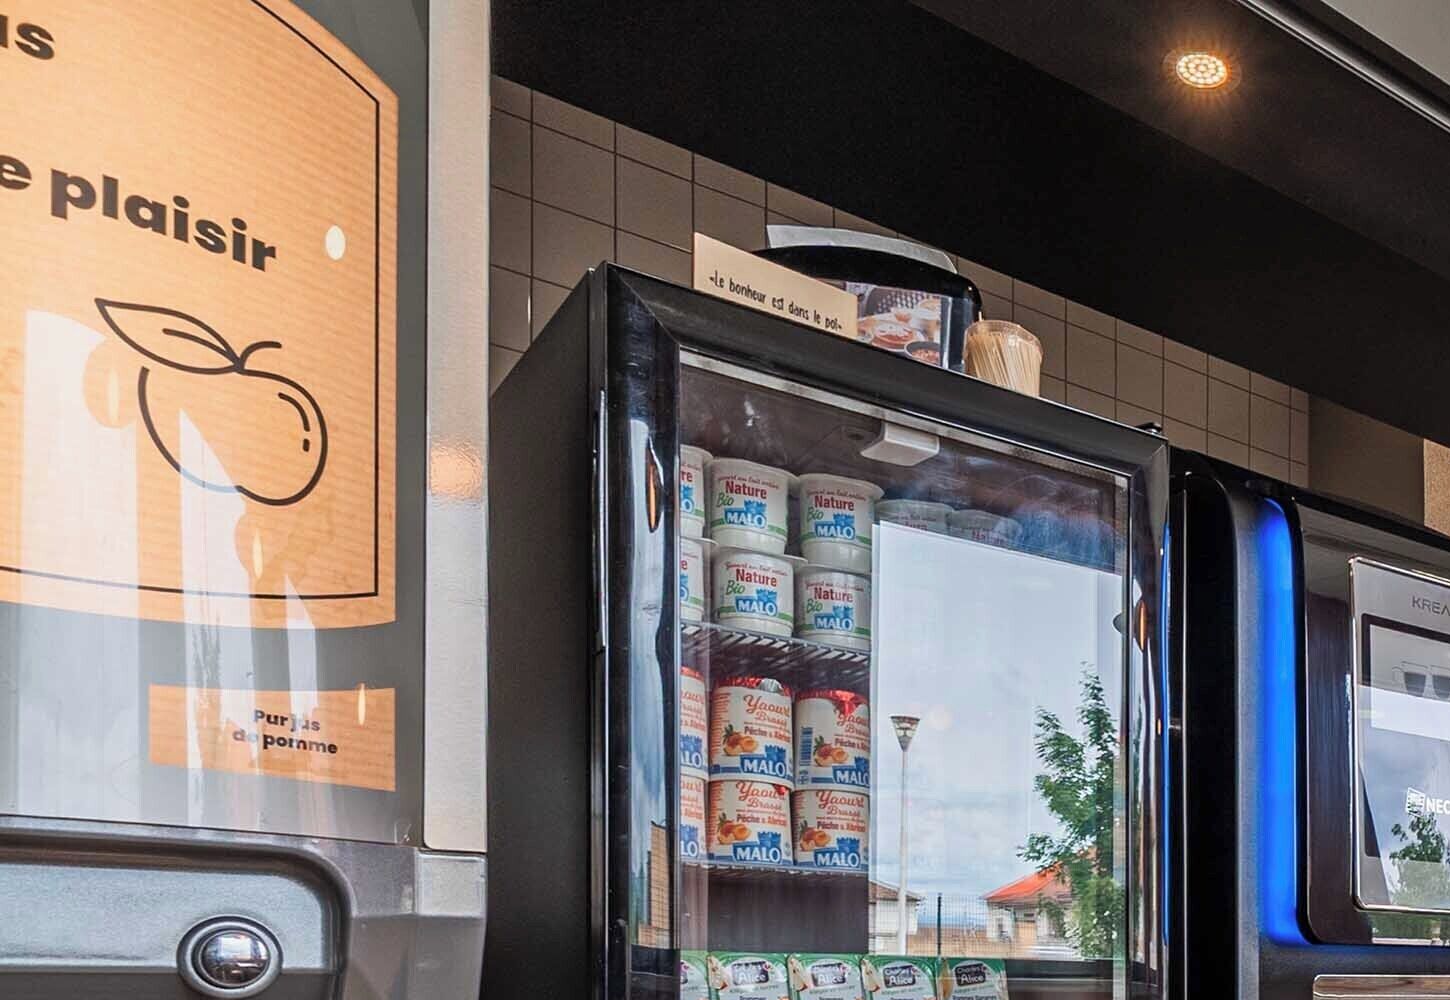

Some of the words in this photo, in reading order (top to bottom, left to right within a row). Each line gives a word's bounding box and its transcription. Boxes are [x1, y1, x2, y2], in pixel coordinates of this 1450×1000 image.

[0, 14, 55, 61] s
[51, 168, 277, 272] plaisir
[729, 277, 766, 304] bonheur
[772, 296, 784, 310] est
[789, 302, 809, 320] dans
[813, 310, 821, 324] le
[725, 480, 767, 499] Nature
[716, 492, 734, 508] Bio
[815, 495, 855, 512] Nature
[726, 511, 766, 529] MALO
[807, 507, 824, 522] Bio
[816, 526, 855, 540] MALO
[735, 568, 777, 587] Nature
[726, 580, 746, 595] Bio
[814, 587, 853, 603] Nature
[738, 600, 777, 617] MALO
[806, 598, 823, 614] Bio
[1411, 595, 1450, 617] KREA
[816, 618, 853, 632] MALO
[254, 709, 288, 727] Pur
[290, 712, 321, 732] jus
[262, 732, 338, 755] pomme
[743, 758, 786, 777] MALO
[736, 847, 781, 863] MALO
[816, 852, 860, 867] MALO
